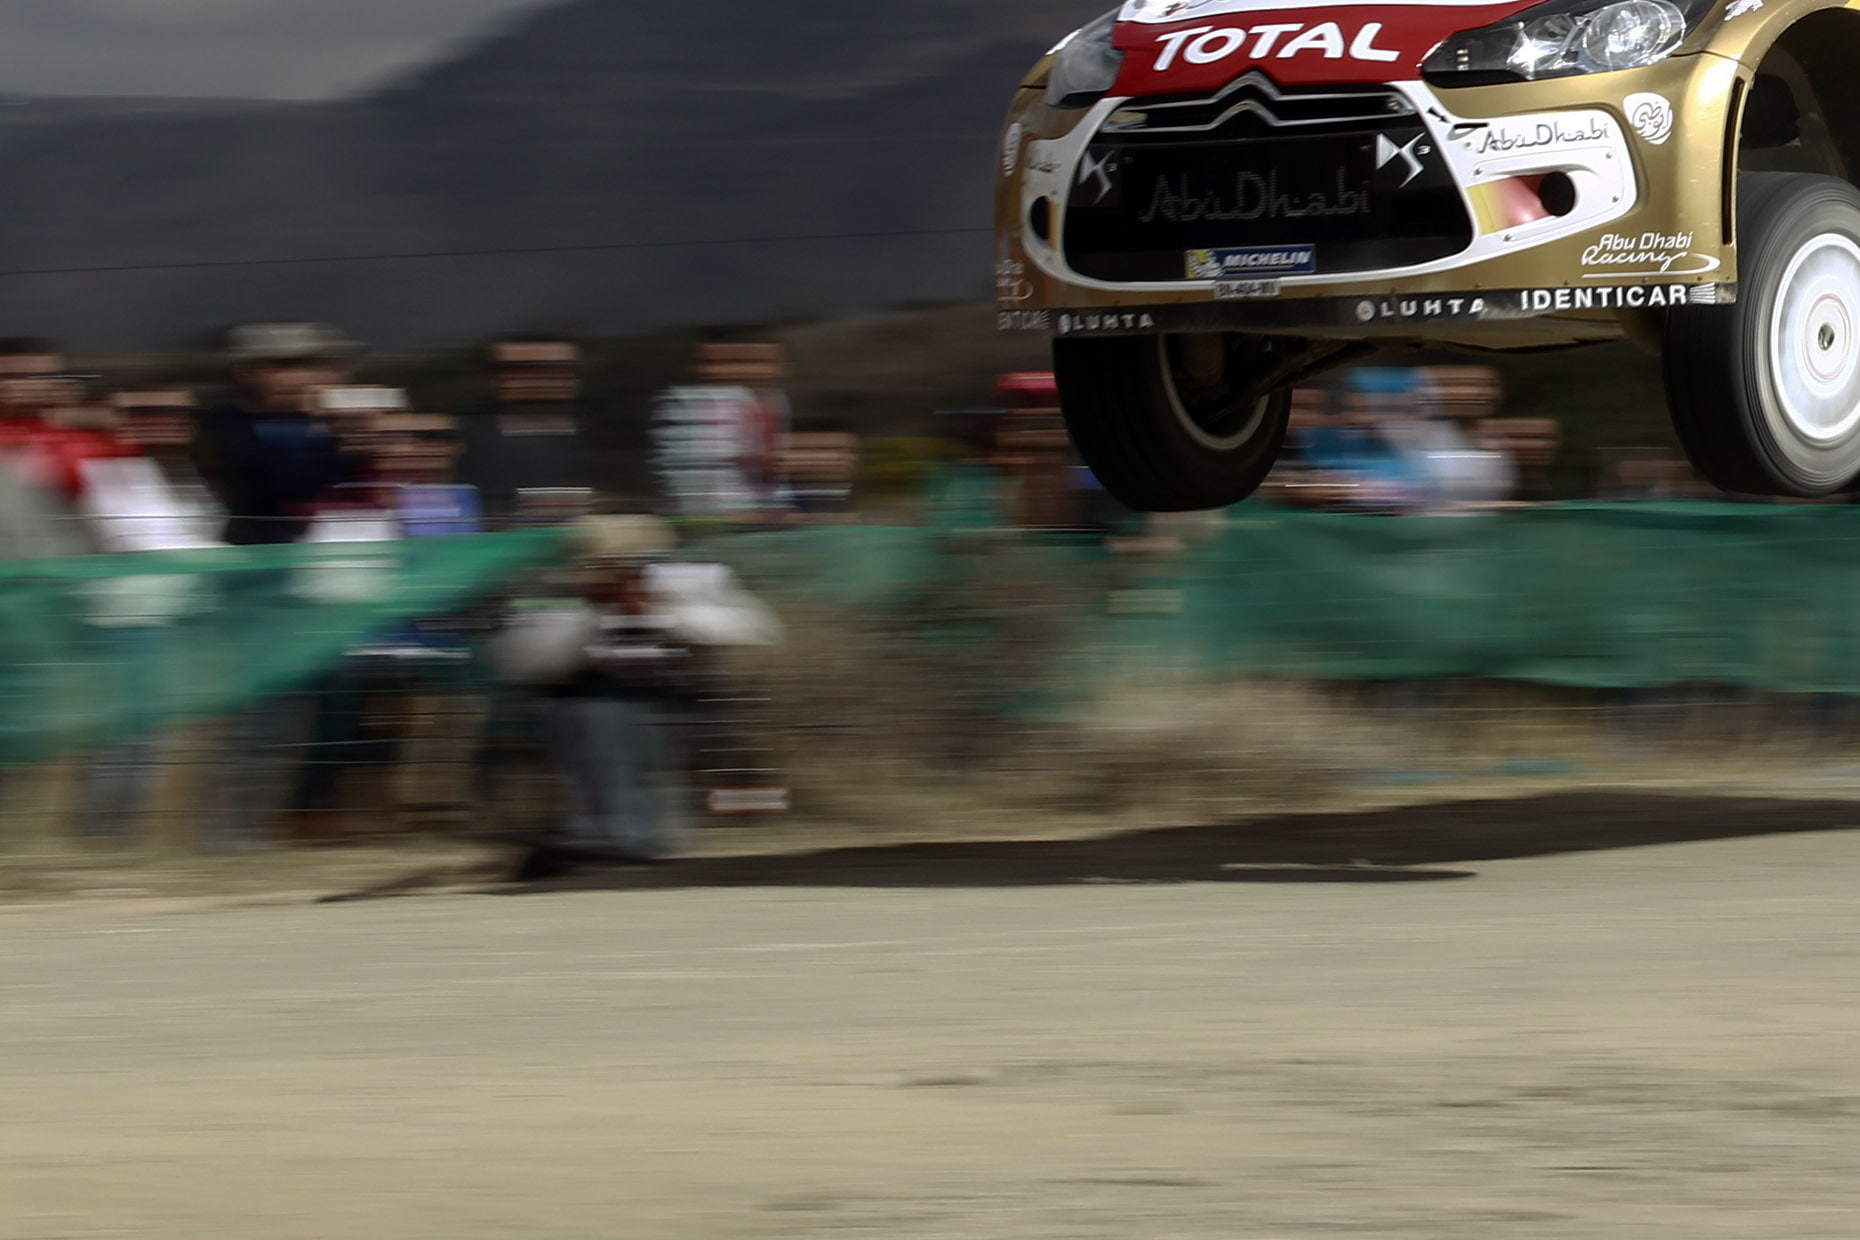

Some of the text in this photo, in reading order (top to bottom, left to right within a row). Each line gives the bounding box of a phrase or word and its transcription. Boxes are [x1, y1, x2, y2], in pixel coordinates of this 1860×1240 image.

[1153, 22, 1401, 71] TOTAL
[1599, 231, 1694, 251] Abu Dhabi
[1223, 251, 1311, 268] MICHELIN
[1581, 246, 1687, 273] Racing
[1380, 298, 1485, 318] LUHTA
[1521, 285, 1687, 311] IDENTICAR
[1072, 313, 1154, 332] LUHTA
